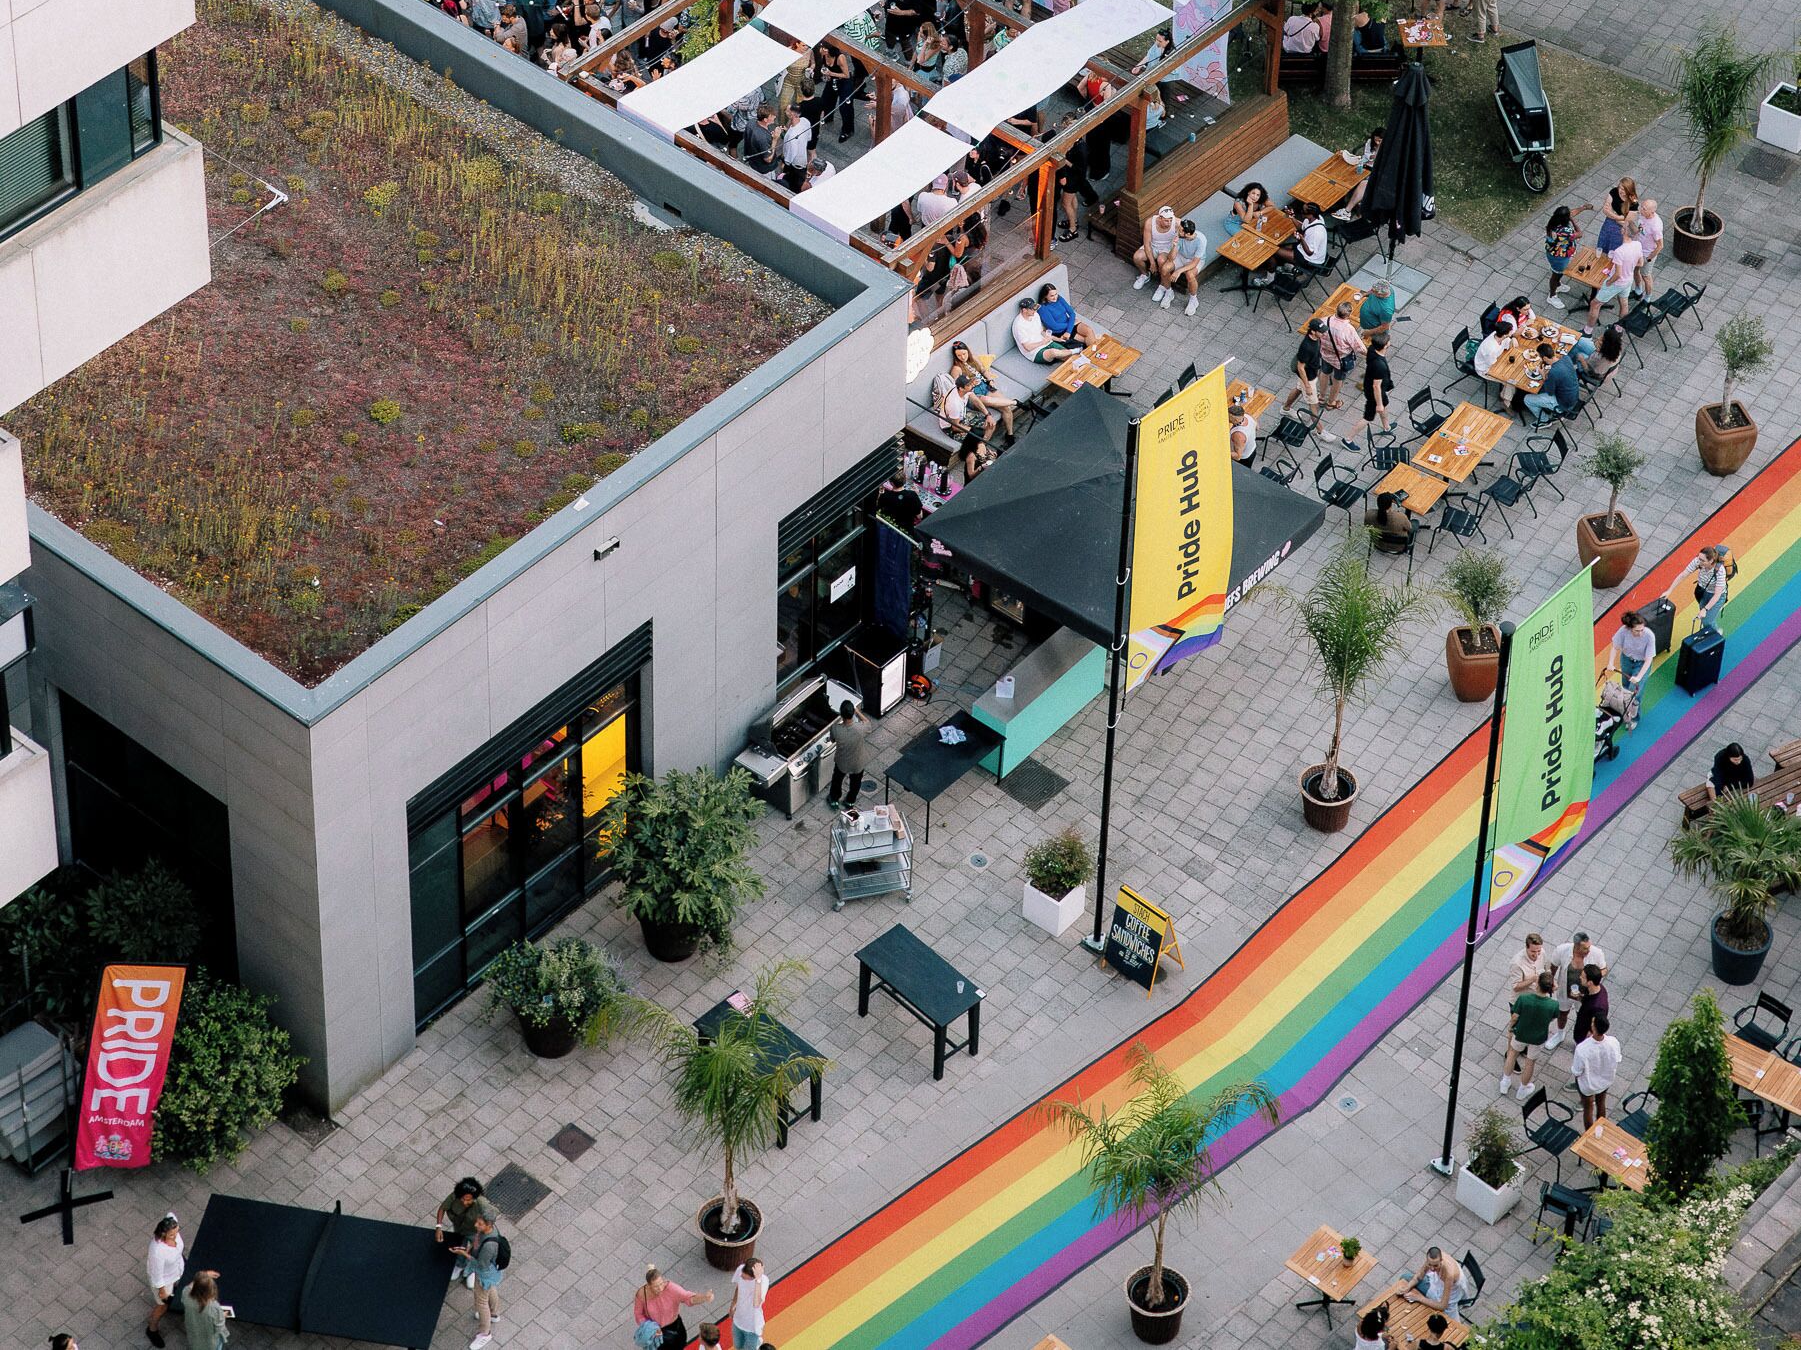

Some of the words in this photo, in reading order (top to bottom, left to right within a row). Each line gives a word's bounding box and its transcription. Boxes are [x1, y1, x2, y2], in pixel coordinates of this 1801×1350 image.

[1158, 413, 1185, 439] PRIDE
[1176, 449, 1200, 517] Hub
[1177, 518, 1201, 601] Pride
[1224, 585, 1241, 613] EFS
[1242, 550, 1281, 596] BREWING
[1529, 620, 1554, 649] PRIDE
[1544, 654, 1564, 723] Hub
[1540, 723, 1563, 812] Pride
[1111, 923, 1155, 964] SANDWICHES
[1126, 914, 1151, 941] COFFEE
[91, 978, 171, 1115] PRIDE
[88, 1115, 145, 1127] AMSTERDAM
